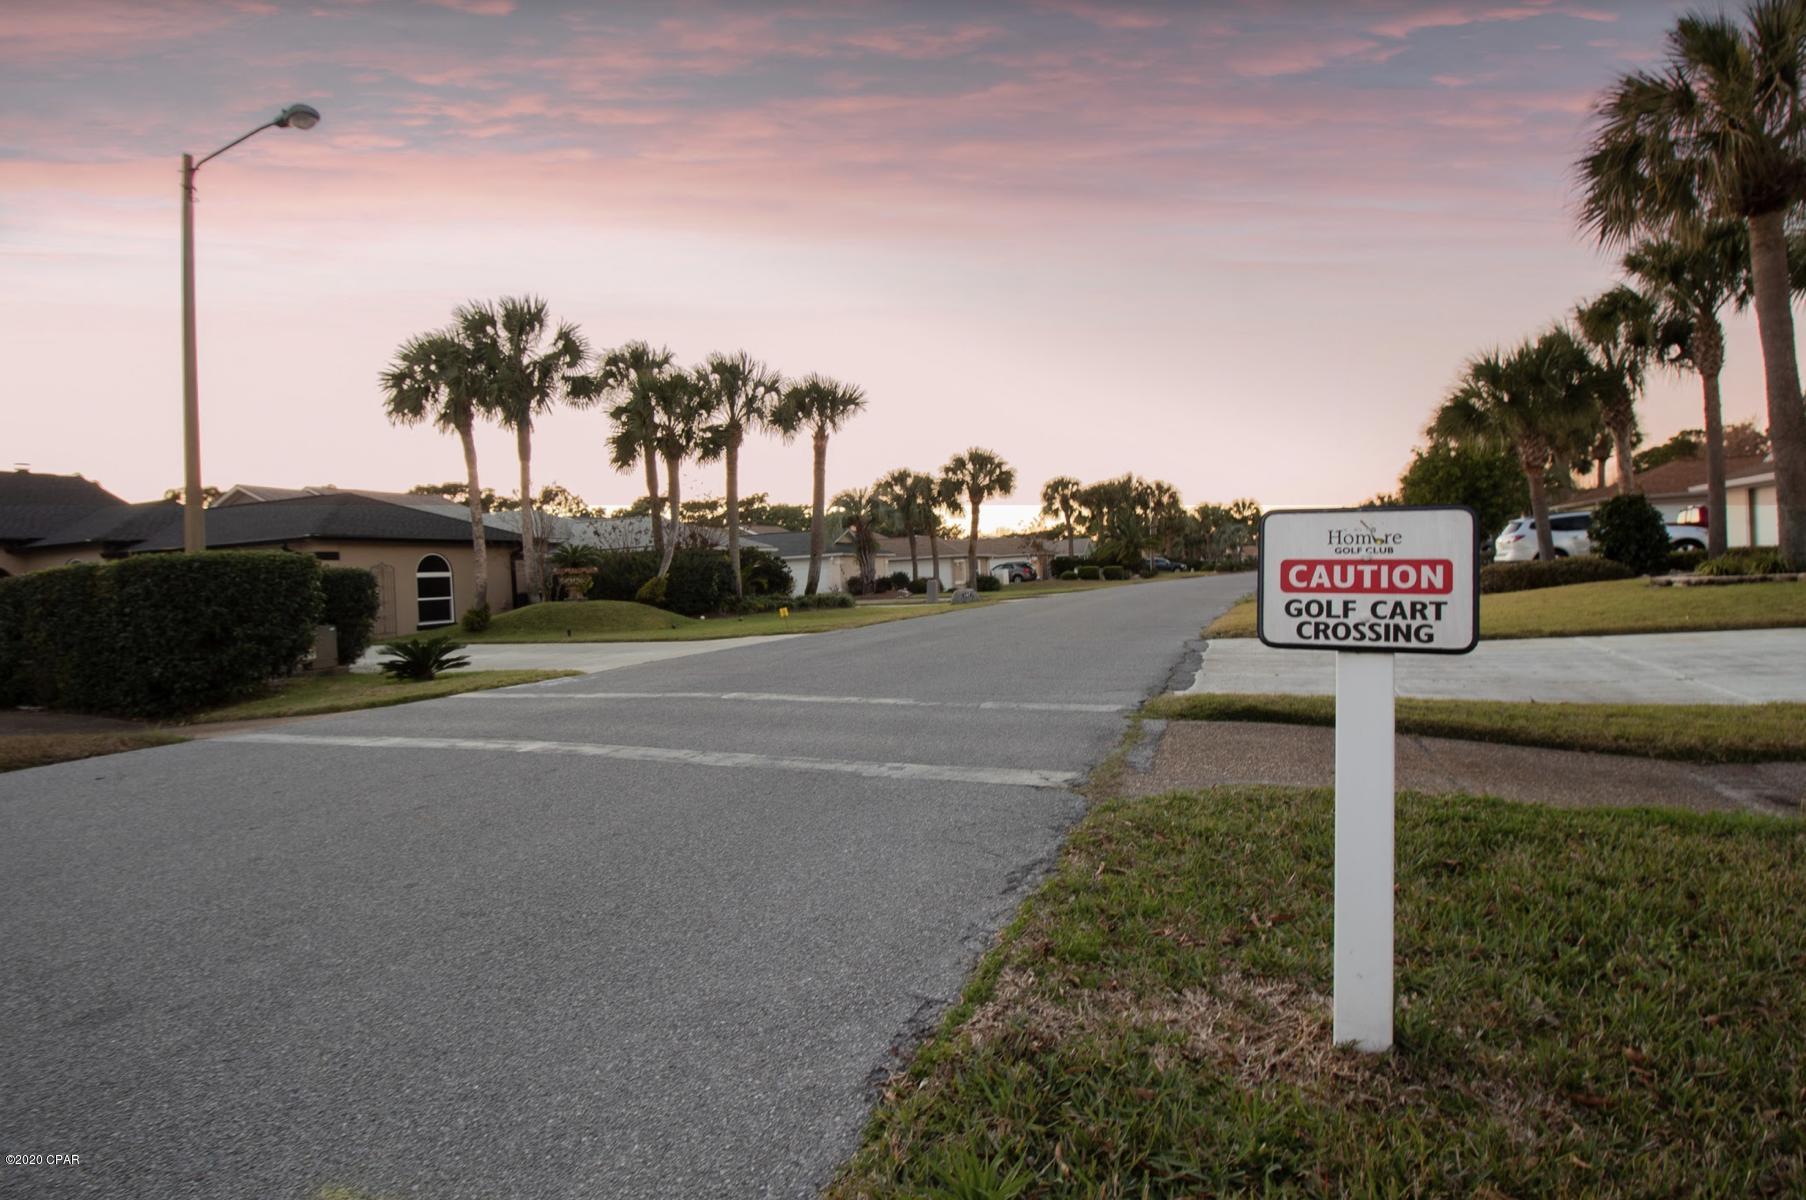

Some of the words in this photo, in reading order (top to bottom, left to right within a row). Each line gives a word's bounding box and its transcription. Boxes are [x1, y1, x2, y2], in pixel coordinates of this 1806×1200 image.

[1334, 546, 1363, 555] GOLF
[1365, 546, 1395, 555] CLUB
[1288, 564, 1444, 590] CAUTION
[1284, 598, 1357, 619] GOLF
[1370, 600, 1448, 621] CART
[1296, 620, 1435, 644] CROSSING
